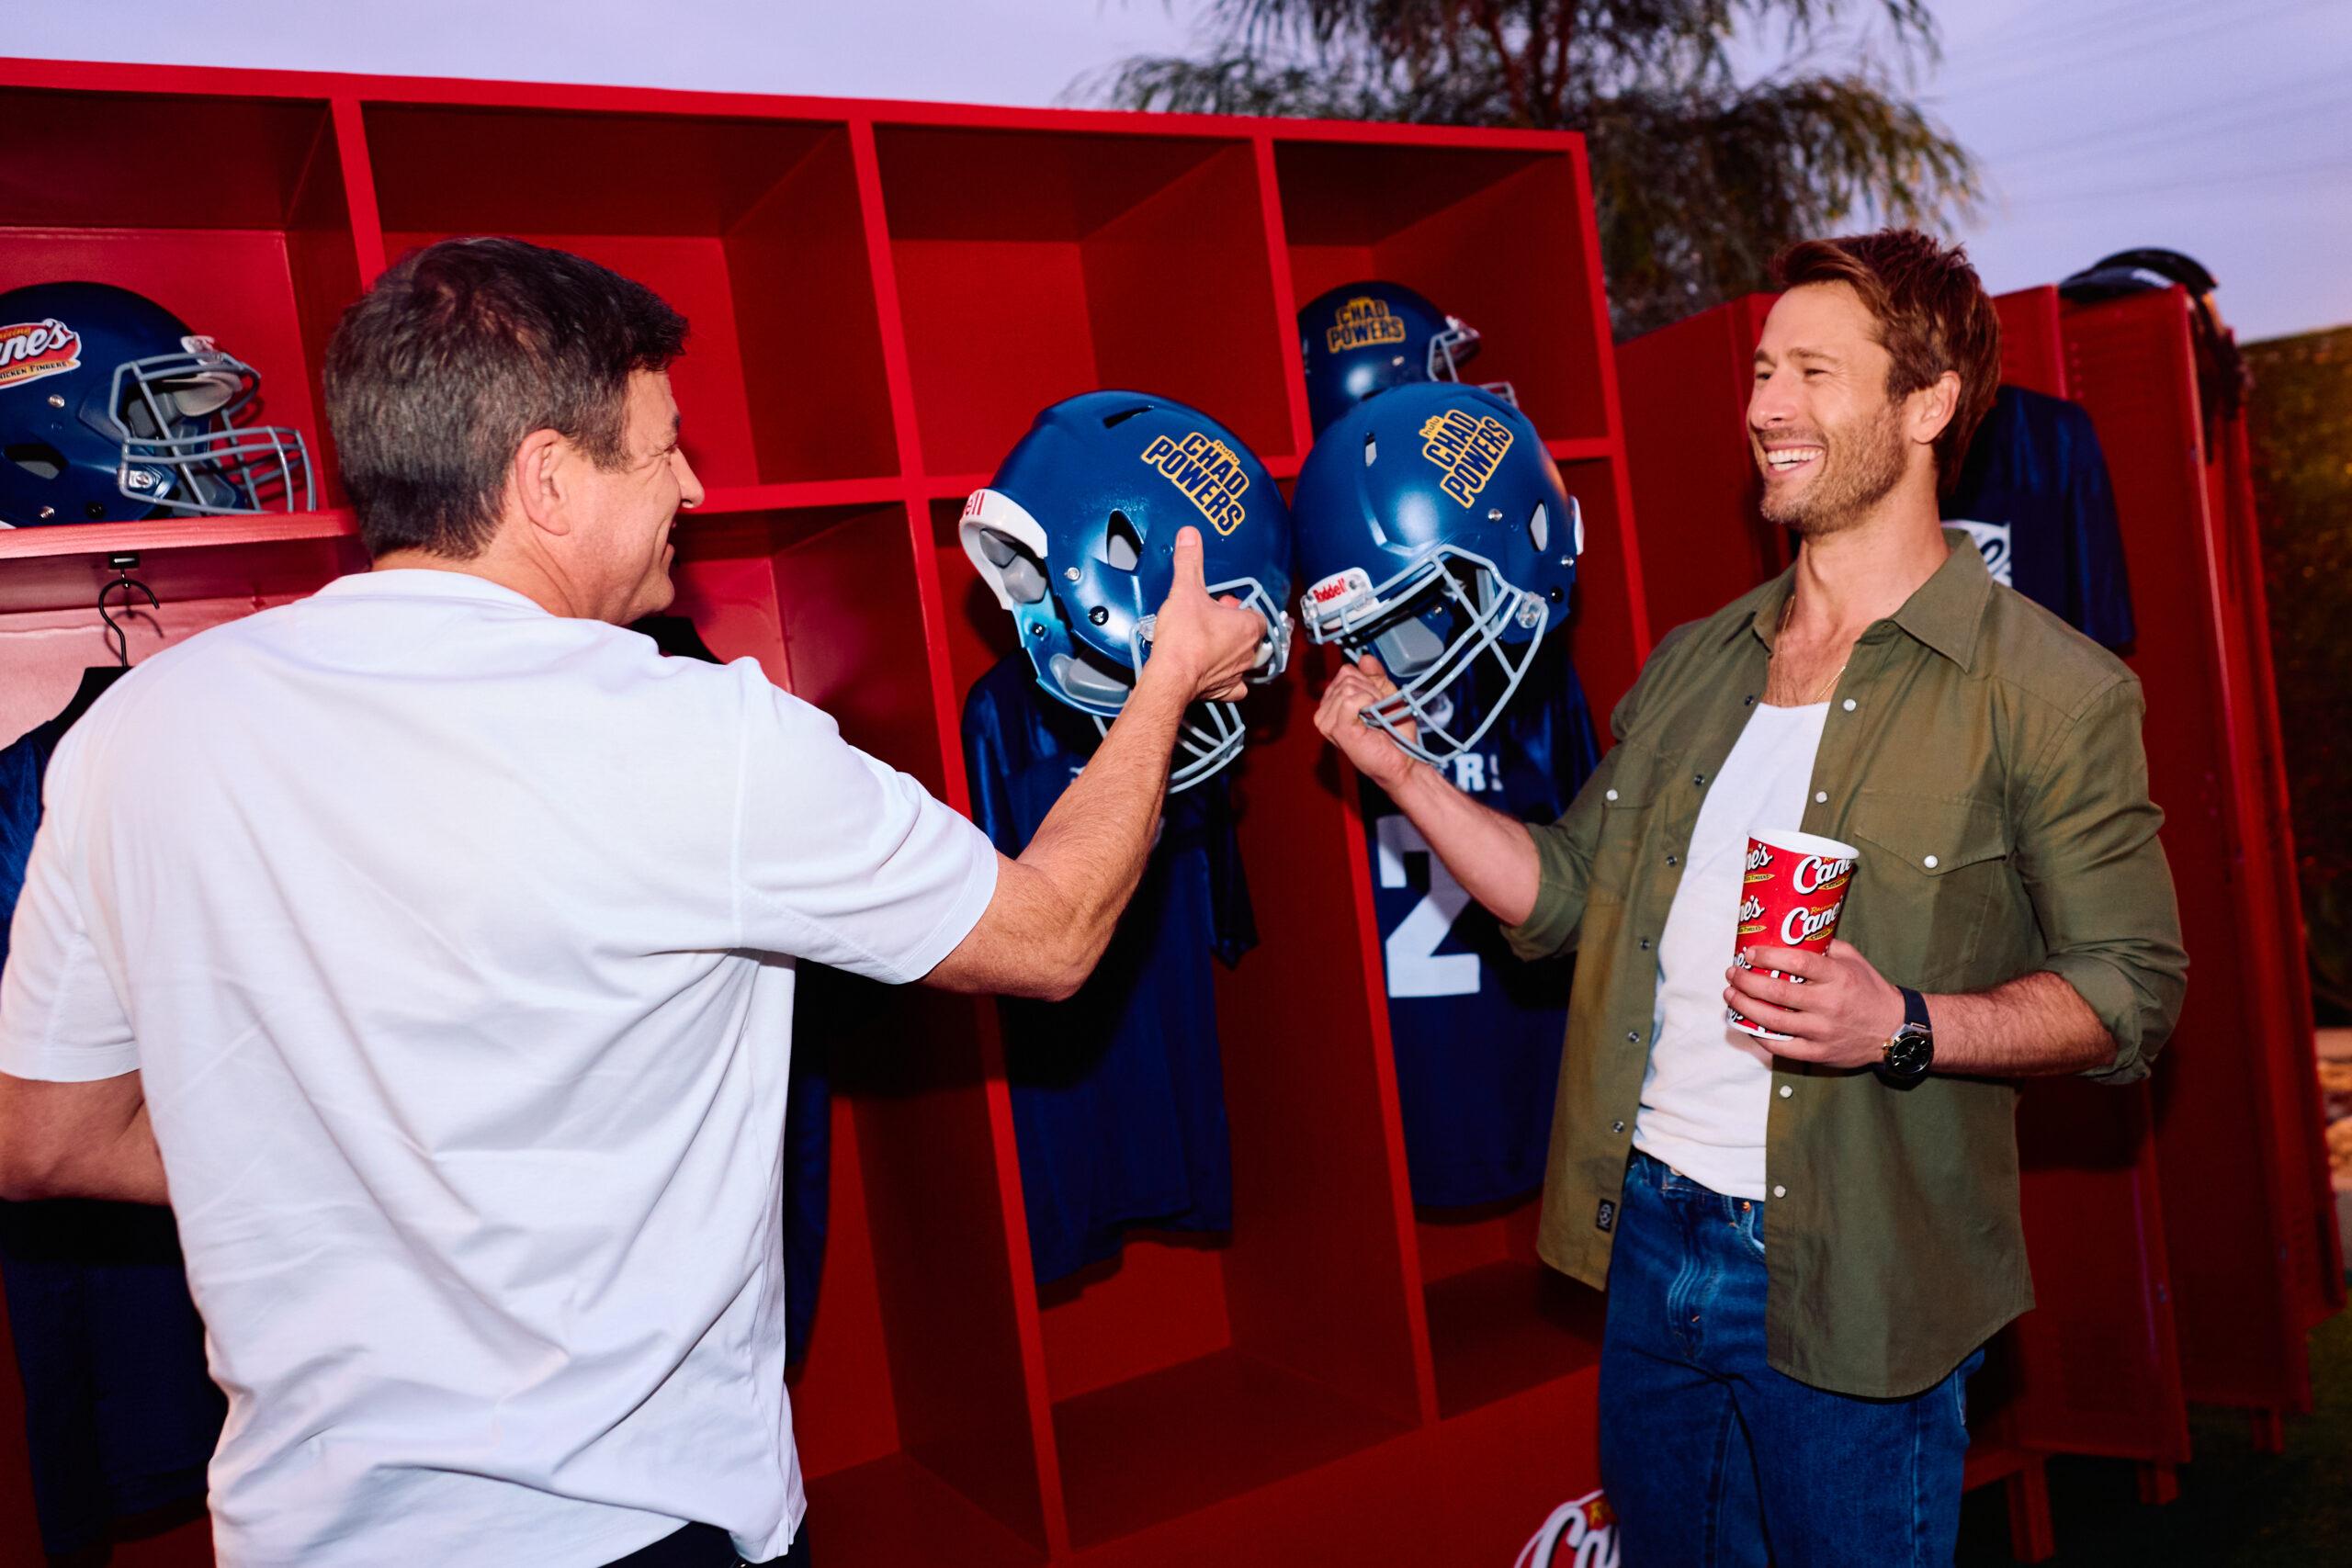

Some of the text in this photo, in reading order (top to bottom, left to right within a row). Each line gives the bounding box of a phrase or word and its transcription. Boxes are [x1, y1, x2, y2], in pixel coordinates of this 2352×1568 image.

[0, 321, 74, 366] ne's
[1330, 320, 1401, 347] POWERS
[0, 367, 27, 379] ICKEN
[1422, 417, 1441, 436] hulu
[1425, 412, 1478, 468] CHAD
[1145, 438, 1243, 532] POWERS
[1182, 434, 1248, 496] CHAD
[1442, 418, 1510, 504] POWERS
[1376, 814, 1480, 998] 2
